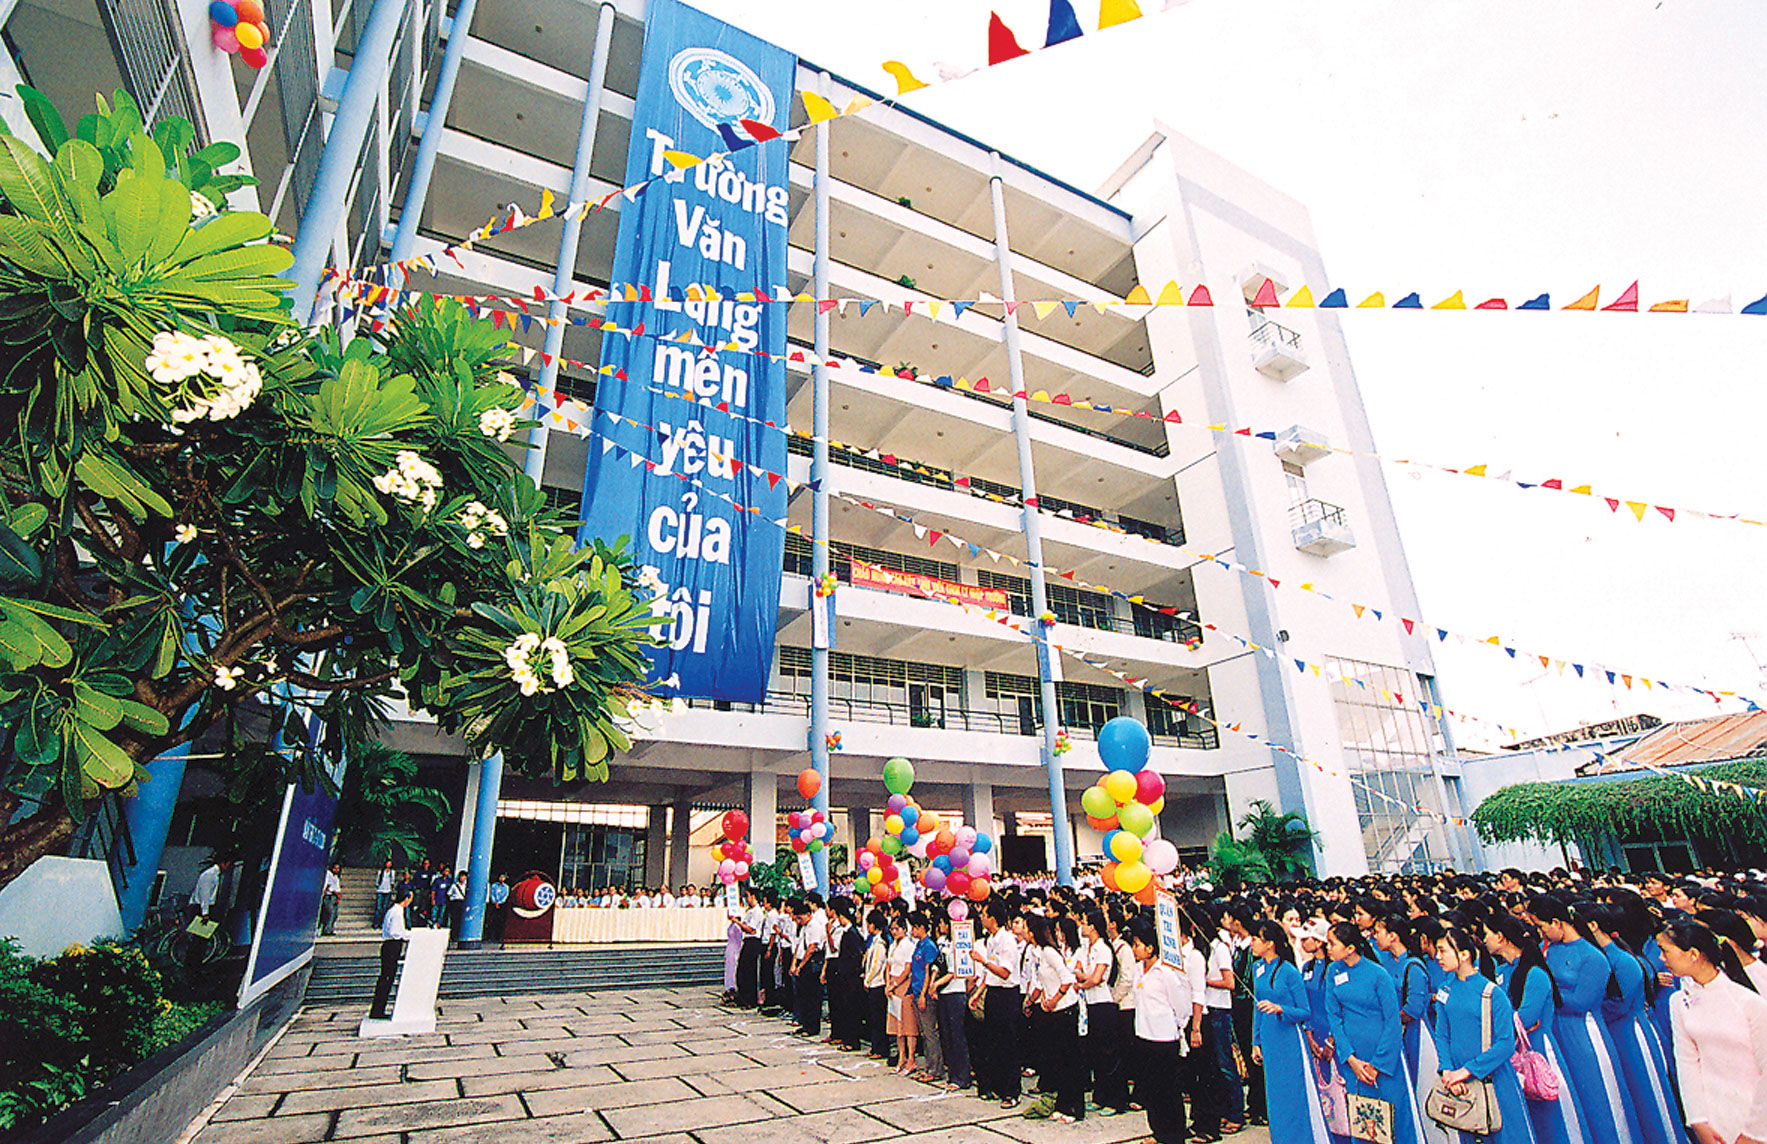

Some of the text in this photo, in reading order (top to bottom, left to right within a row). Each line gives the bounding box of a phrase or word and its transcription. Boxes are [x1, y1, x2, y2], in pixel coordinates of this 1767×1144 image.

[673, 199, 747, 271] Văn
[654, 260, 764, 353] Lang
[653, 420, 735, 481] yêu
[647, 492, 732, 565] của
[648, 584, 712, 654] tôi
